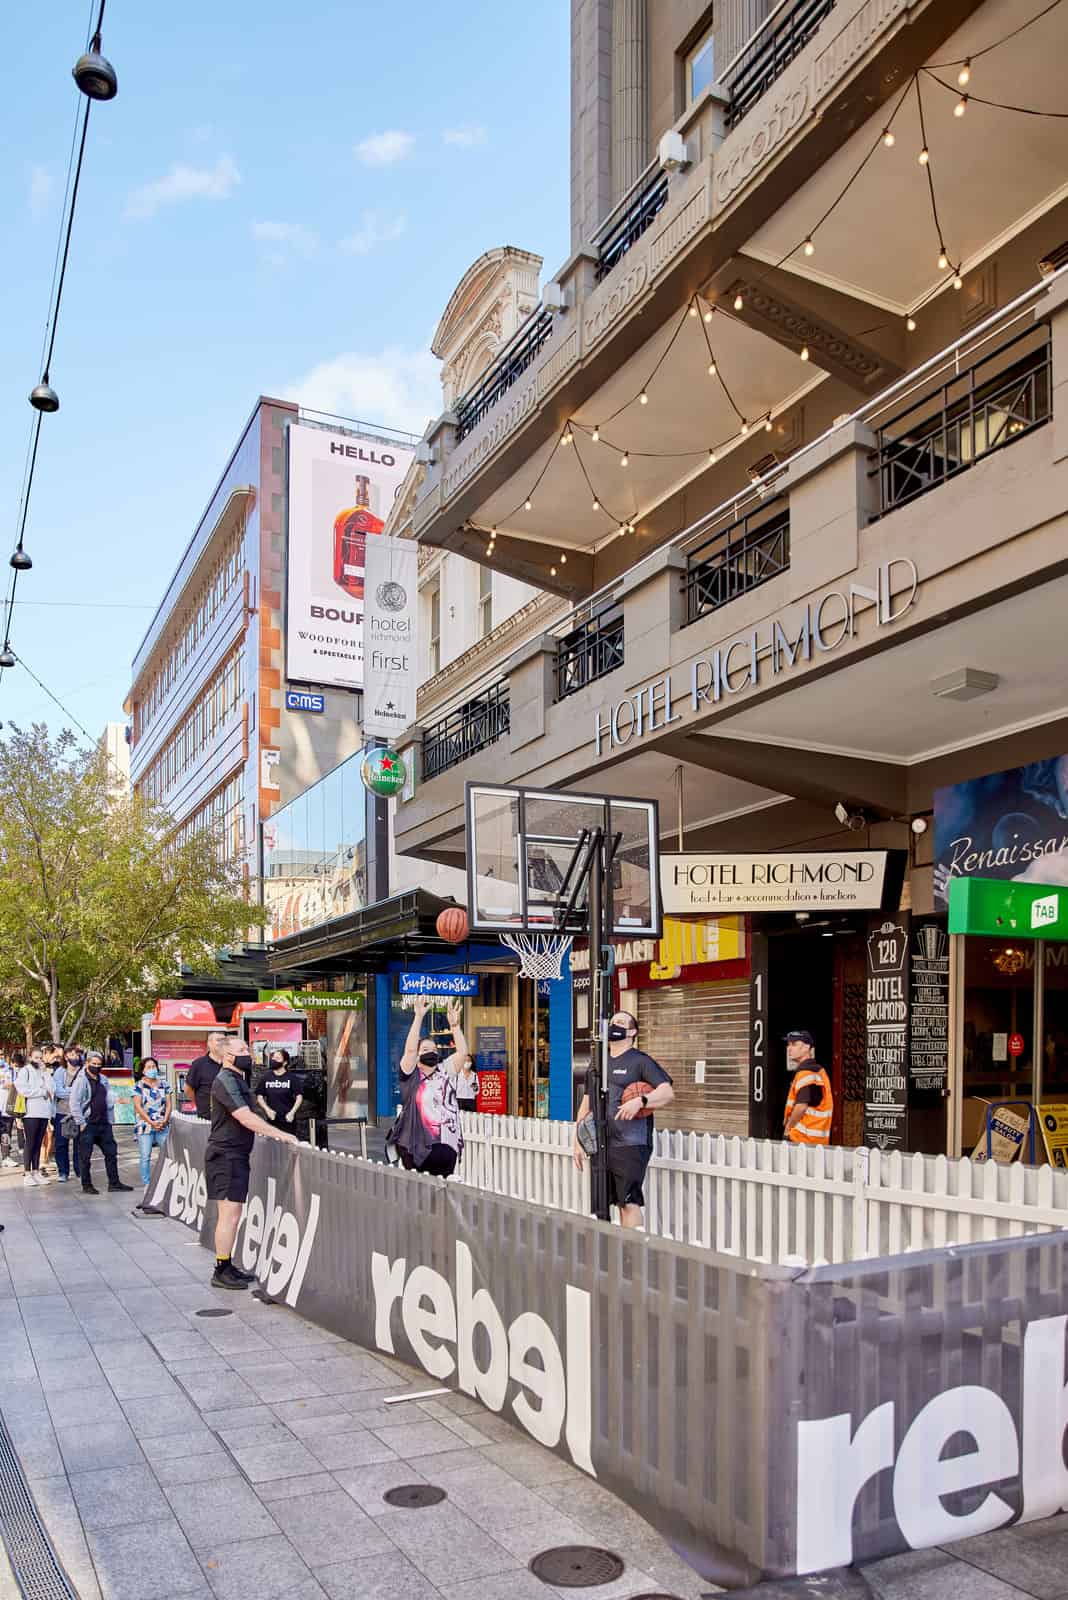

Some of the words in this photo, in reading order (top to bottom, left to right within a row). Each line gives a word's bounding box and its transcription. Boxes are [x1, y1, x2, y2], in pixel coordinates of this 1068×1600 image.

[330, 442, 396, 467] HELLO
[371, 616, 411, 632] hotel
[372, 650, 409, 672] first
[595, 675, 682, 757] HOTEL
[690, 558, 920, 712] RICHMOND
[374, 709, 407, 719] Heineken
[674, 864, 744, 886] HOTEL
[751, 862, 874, 885] RICHMOND
[819, 888, 857, 900] functions
[1035, 903, 1055, 918] TAB
[878, 939, 897, 964] 128
[867, 976, 904, 1001] HOTEL
[866, 1001, 907, 1024] RICHMOND
[265, 1080, 290, 1089] rebel
[481, 1081, 502, 1089] 50%
[481, 1089, 501, 1097] OFF
[150, 1148, 208, 1232] rebe
[371, 1239, 598, 1480] rebel
